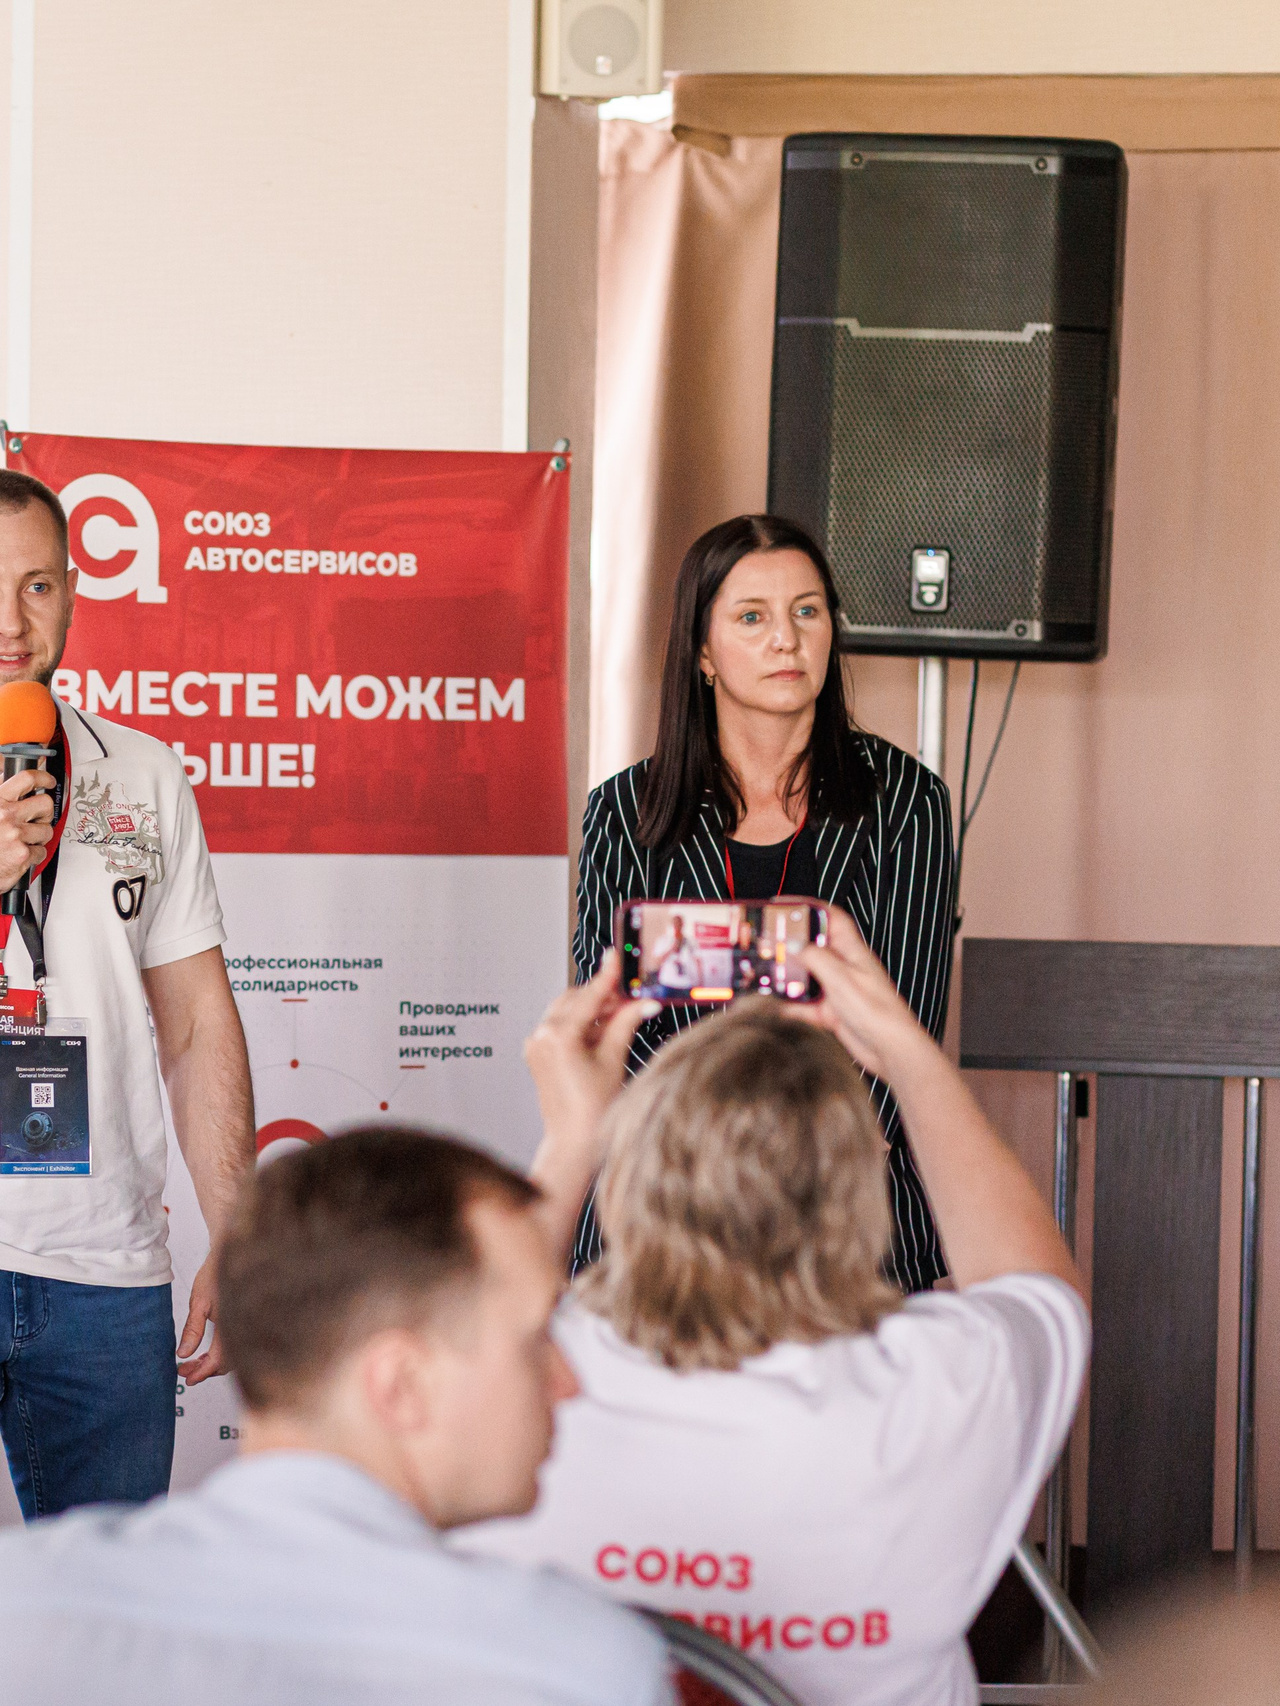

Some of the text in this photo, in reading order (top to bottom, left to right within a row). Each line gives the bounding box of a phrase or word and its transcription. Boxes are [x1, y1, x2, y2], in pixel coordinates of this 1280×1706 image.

[184, 510, 271, 538] СОЮЗ
[184, 547, 418, 578] АВТОСЕРВИСОВ
[51, 668, 525, 722] ВМЕСТЕ МОЖЕМ
[163, 741, 316, 788] ЬШЕ!
[53, 783, 62, 825] chnologies
[112, 872, 147, 922] 07
[231, 980, 359, 994] солидарность
[399, 1001, 500, 1017] Проводник
[399, 1023, 456, 1037] ваших
[399, 1045, 494, 1060] интересов
[595, 1544, 754, 1592] СОЮЗ
[670, 1609, 890, 1652] ВИСОВ
